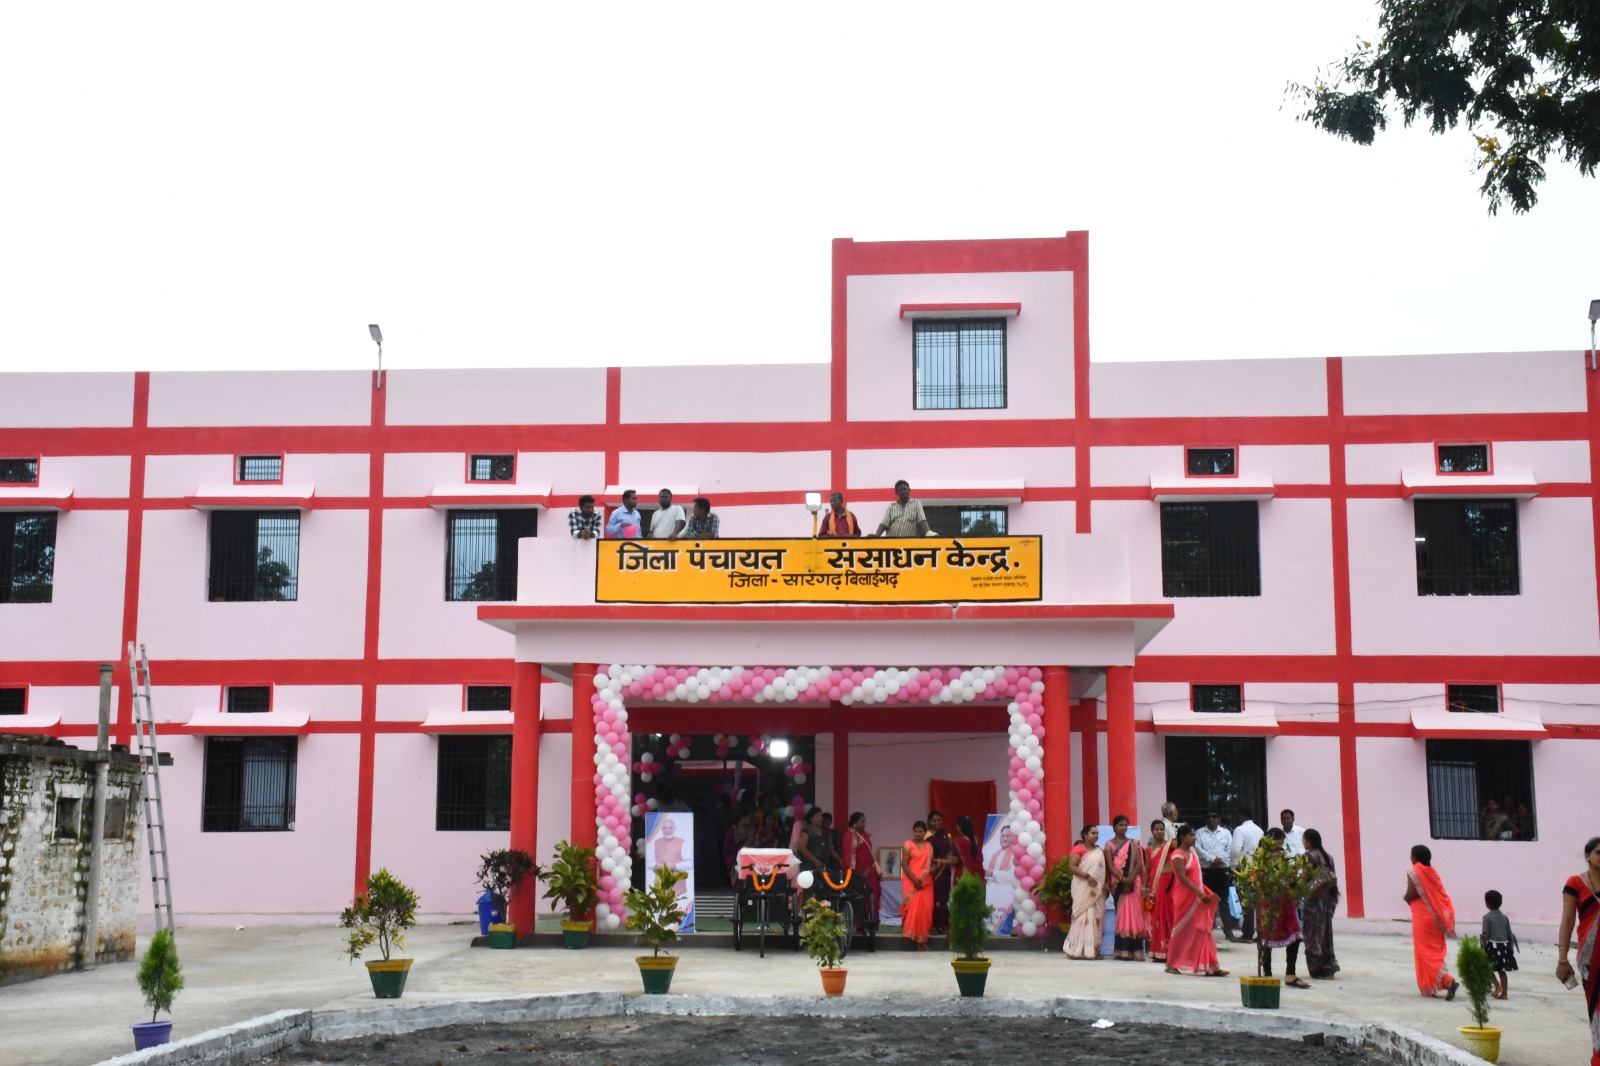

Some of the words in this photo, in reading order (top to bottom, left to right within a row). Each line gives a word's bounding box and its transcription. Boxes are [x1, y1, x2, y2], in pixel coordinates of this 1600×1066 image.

[617, 542, 679, 570] जिला
[686, 542, 787, 570] पंचायत
[824, 542, 942, 569] संसाधन
[781, 568, 843, 590] सारंगढ़
[845, 570, 900, 588] बिलाईगढ़
